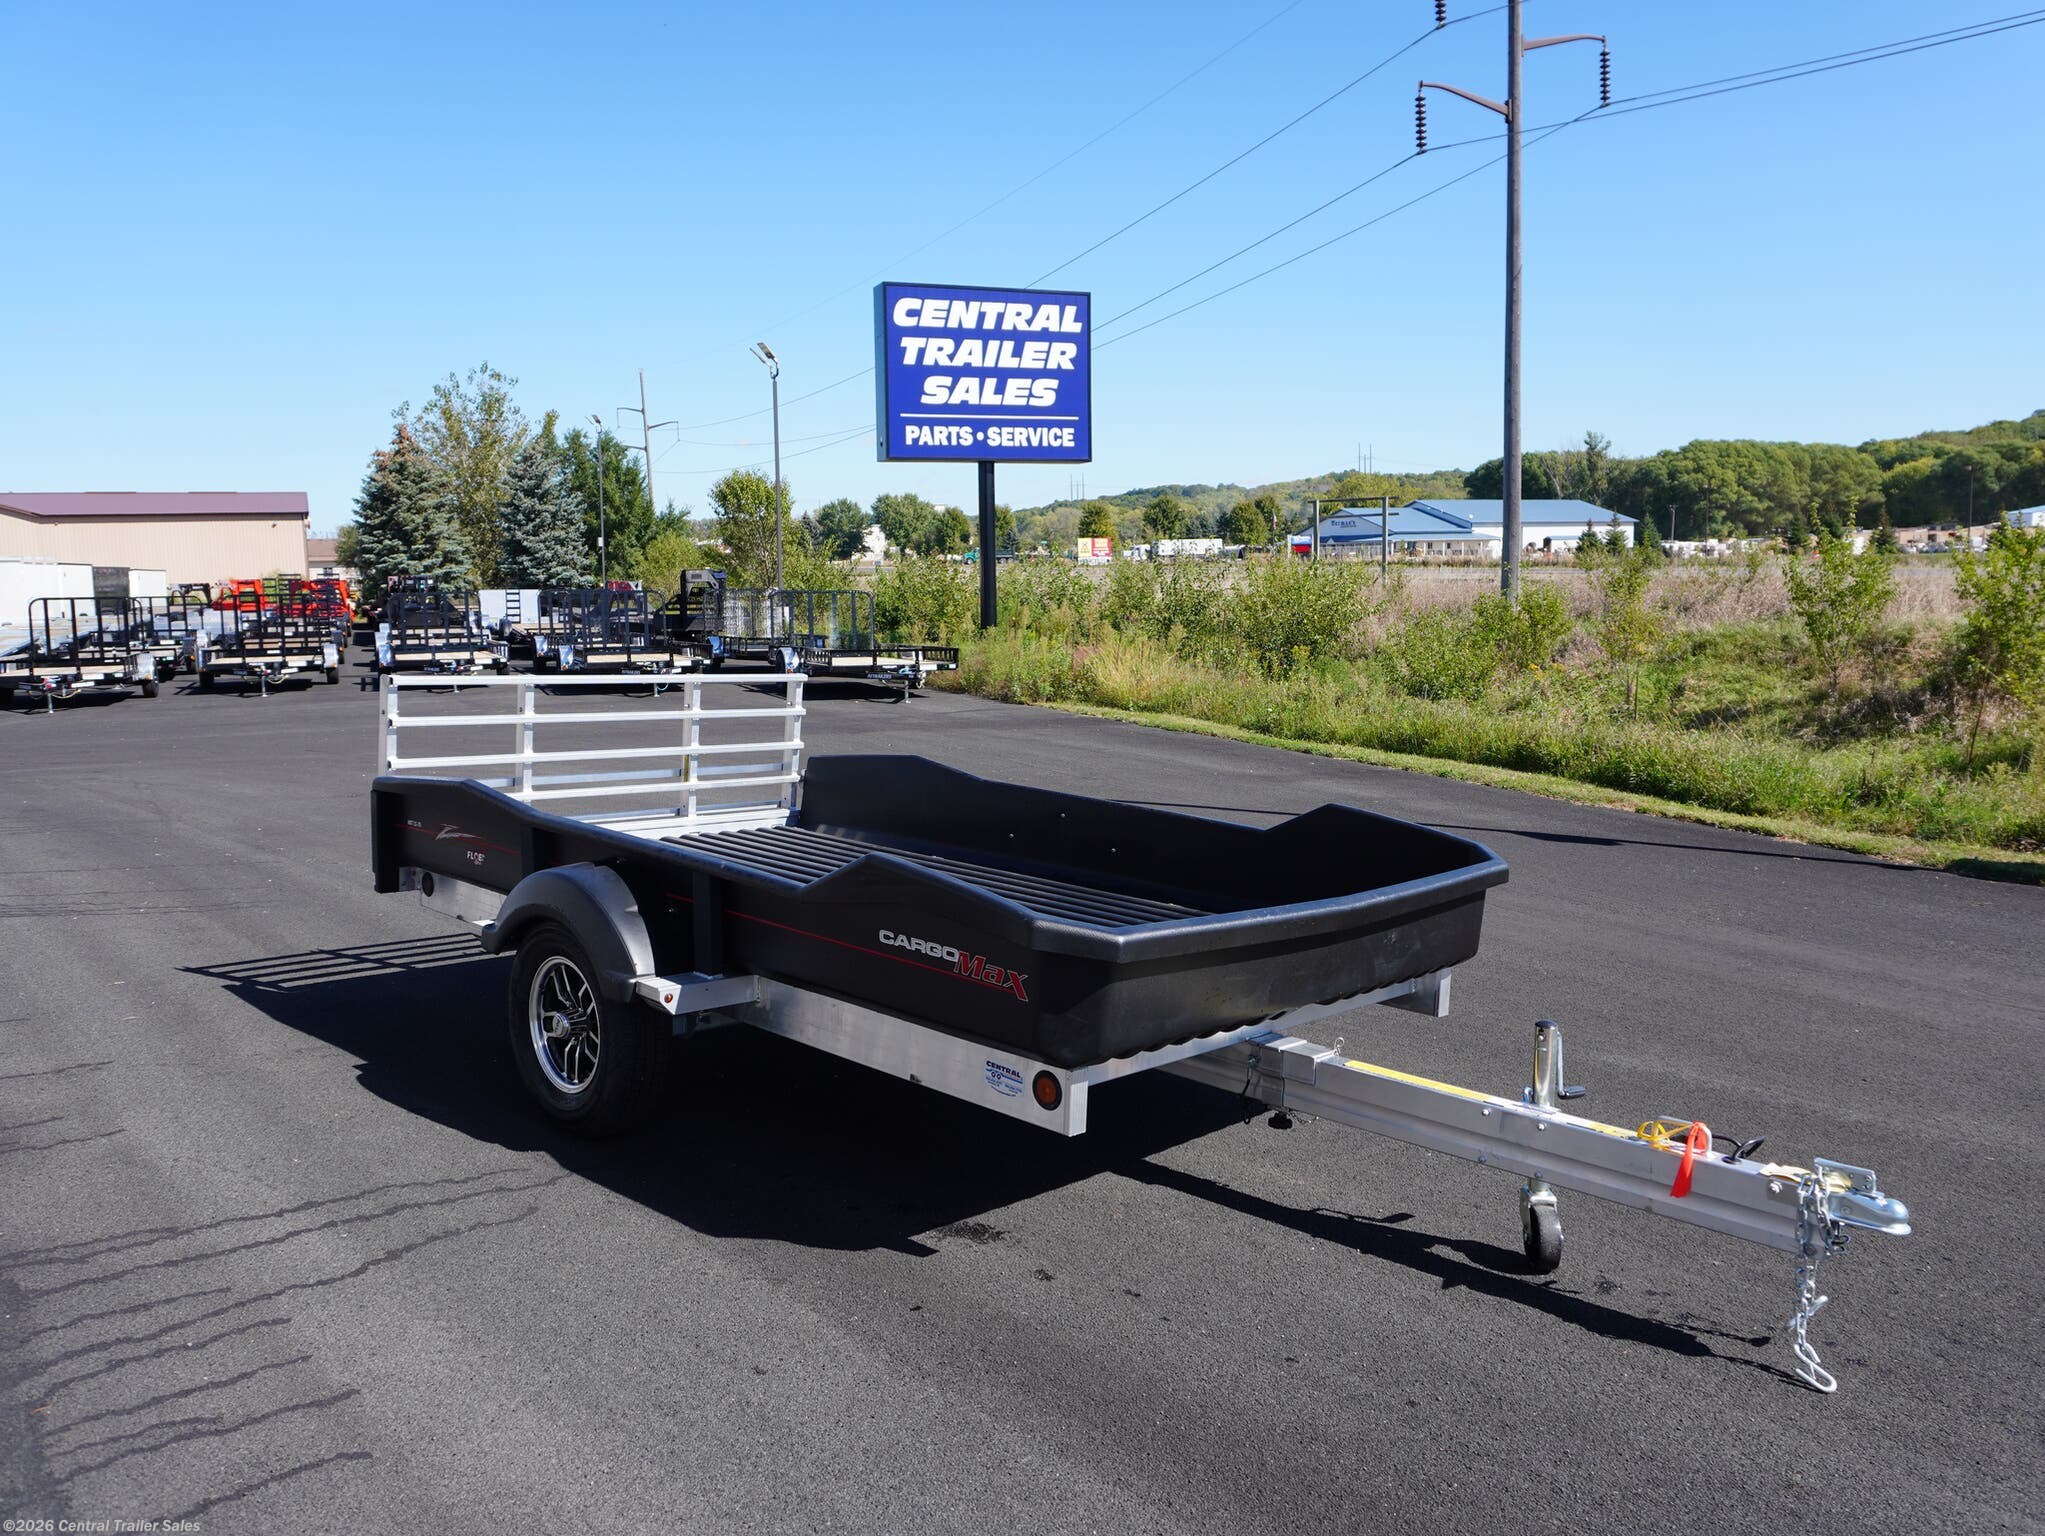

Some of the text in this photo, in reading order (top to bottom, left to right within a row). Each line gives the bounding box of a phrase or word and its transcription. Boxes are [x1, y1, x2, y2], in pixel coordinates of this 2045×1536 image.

[893, 297, 1082, 332] CENTRAL
[901, 337, 1077, 369] TRAILER
[920, 375, 1060, 407] SALES
[905, 425, 1076, 448] PARTS SERVICE
[986, 1060, 1020, 1078] CENTRAL
